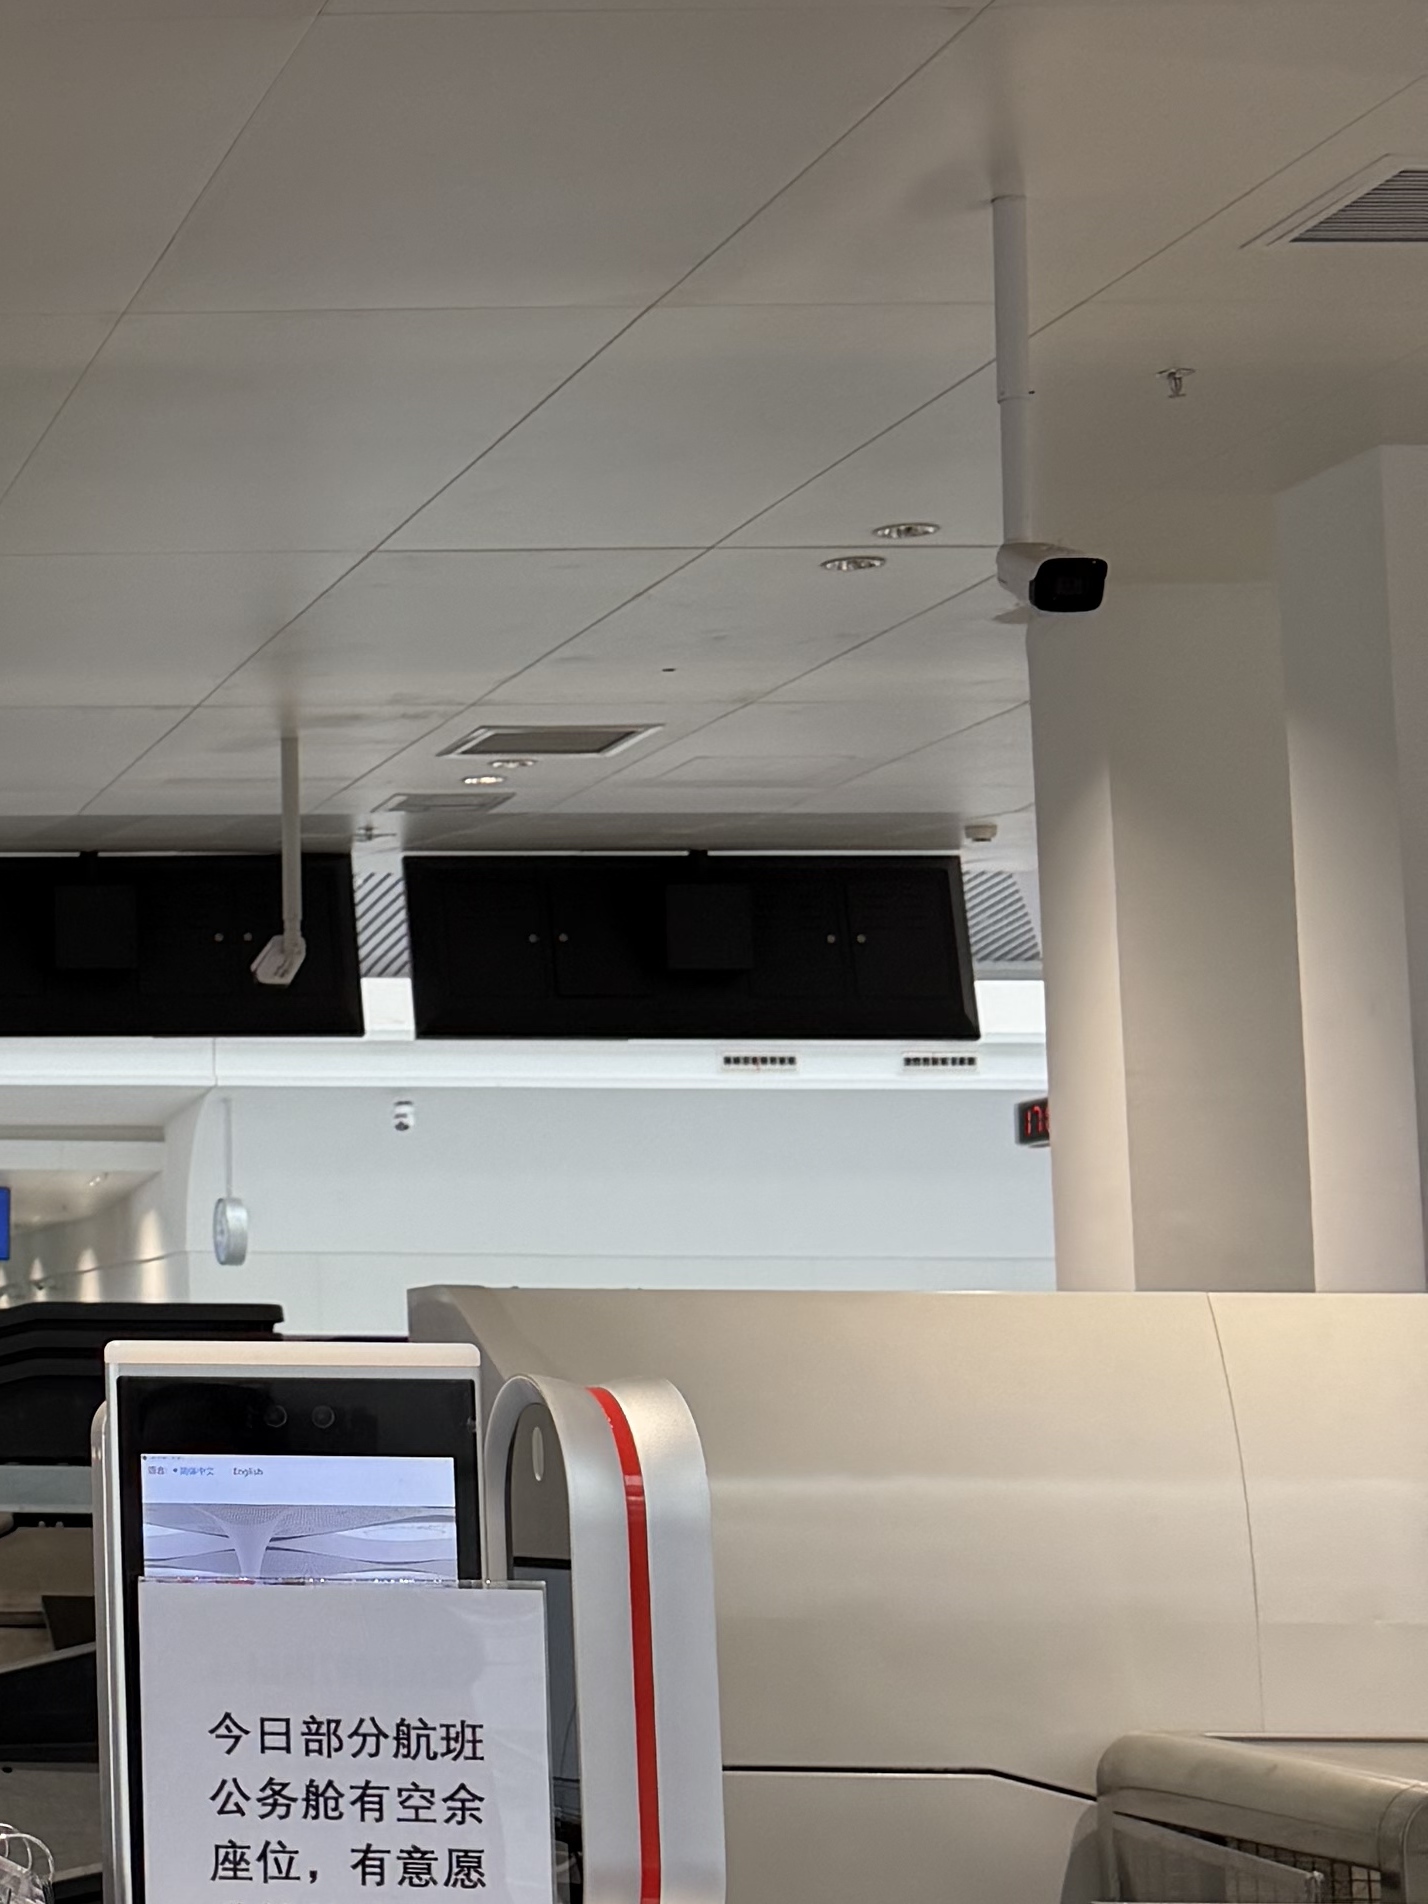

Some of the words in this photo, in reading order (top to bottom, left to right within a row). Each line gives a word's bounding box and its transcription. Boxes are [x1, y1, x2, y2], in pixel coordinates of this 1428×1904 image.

[208, 1710, 486, 1762] 今日部分航班
[209, 1776, 486, 1827] 公务舱有空余
[210, 1839, 487, 1890] 座位，有意愿
